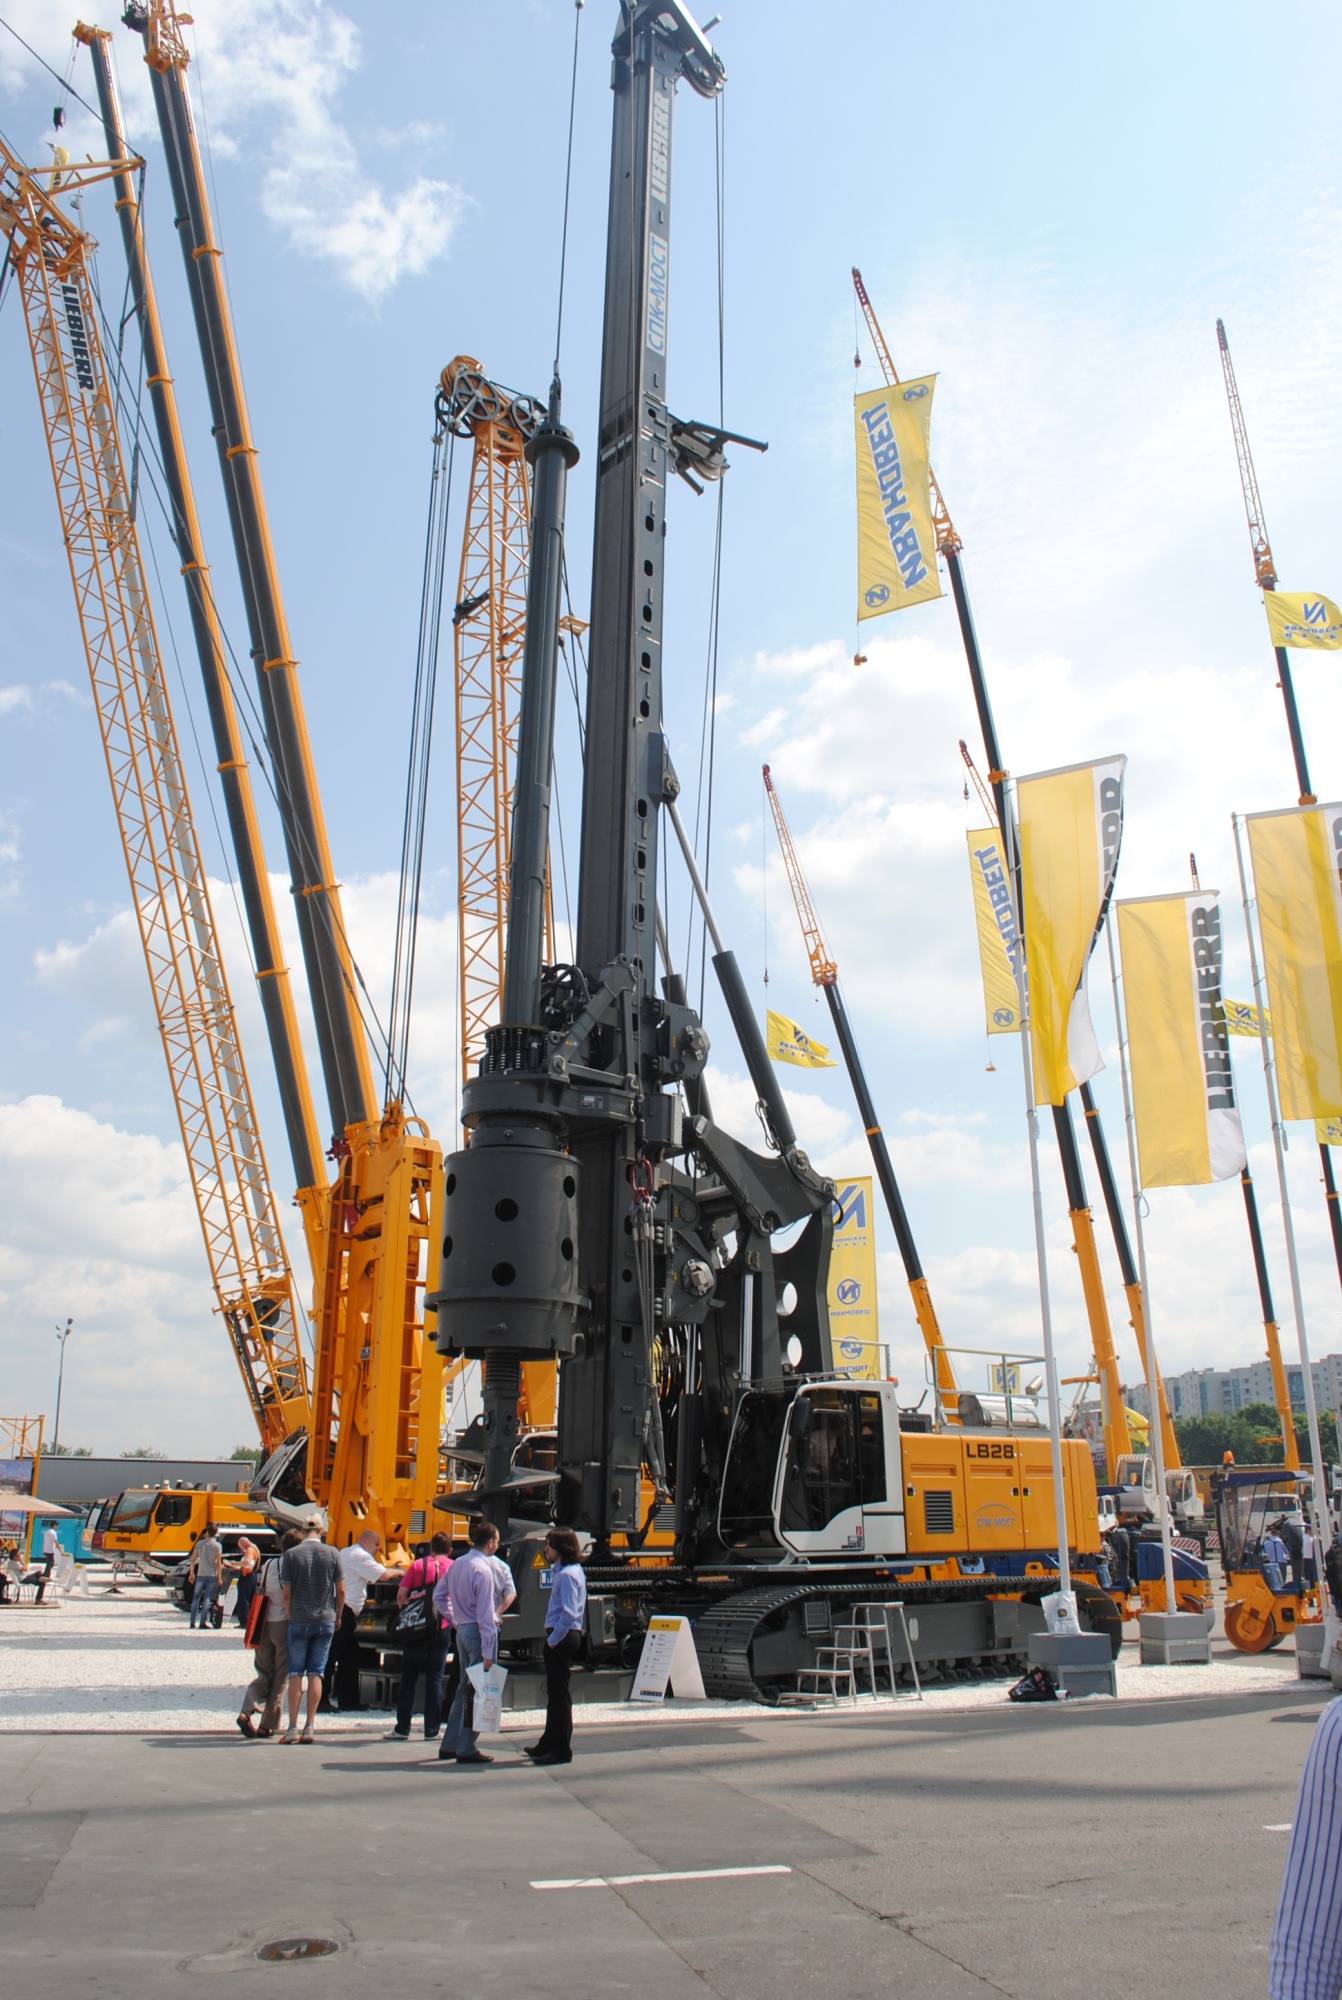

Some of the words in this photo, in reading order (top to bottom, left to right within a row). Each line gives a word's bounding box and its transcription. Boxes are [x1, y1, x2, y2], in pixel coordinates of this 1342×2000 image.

[650, 91, 669, 204] LIEBHERR
[61, 284, 95, 390] LIEBHERR
[648, 235, 667, 351] СПК-МОСТ
[1191, 905, 1235, 1110] LIEBHERR
[966, 1443, 1014, 1459] LB28
[976, 1517, 1014, 1527] СПК-МОСТ
